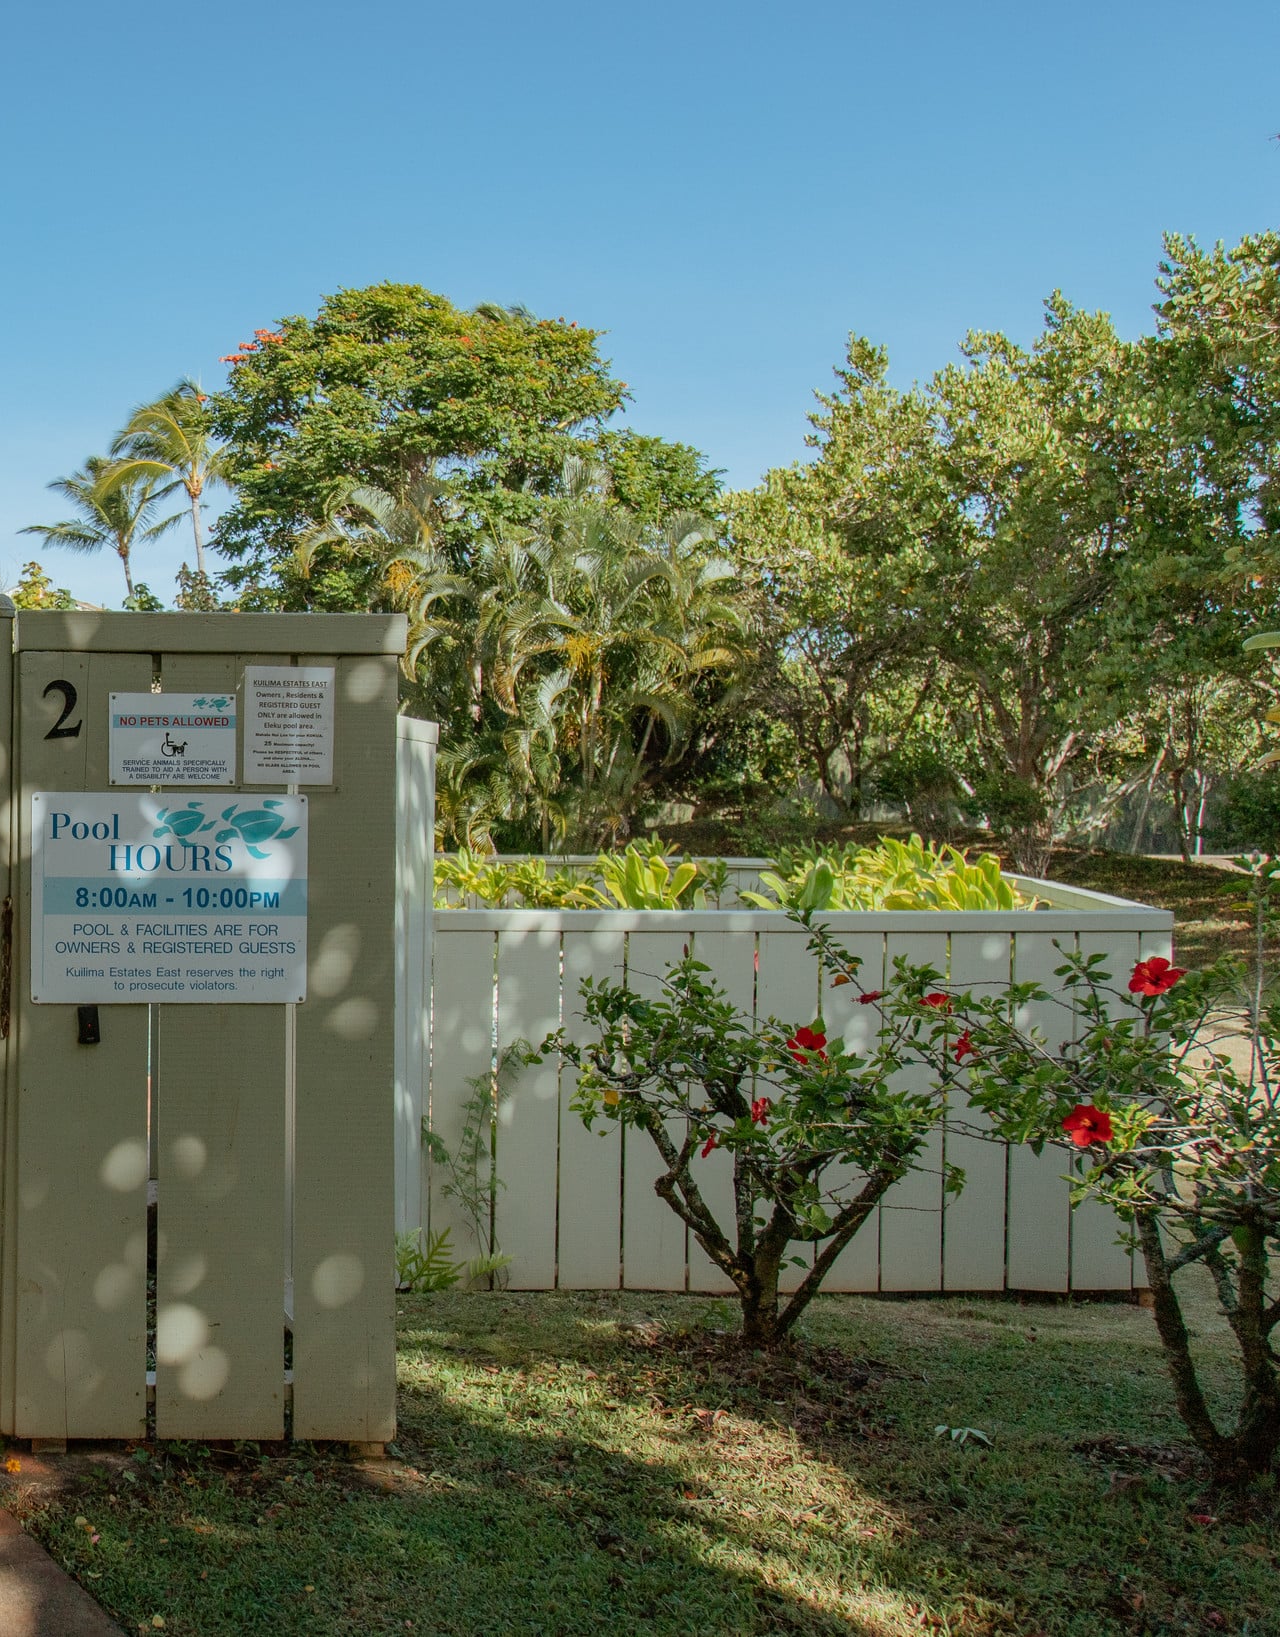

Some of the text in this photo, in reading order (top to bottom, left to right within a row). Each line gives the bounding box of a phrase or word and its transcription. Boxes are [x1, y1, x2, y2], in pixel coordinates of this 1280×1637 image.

[43, 680, 82, 739] 2
[120, 717, 229, 726] NO PETS ALLOWED
[49, 813, 120, 840] Pool
[107, 844, 233, 872] HOURS
[76, 888, 157, 908] 8:00AM
[182, 888, 280, 908] 10:00PM
[73, 924, 279, 936] POOL & FACILITIES ARE FOR
[55, 942, 296, 954] OWNERS & REGISTERED GUESTS
[66, 968, 104, 977] Kuilima
[110, 968, 151, 977] Estates
[157, 968, 181, 977] East
[239, 968, 256, 977] the
[261, 968, 284, 980] right
[114, 981, 238, 992] to prosecute violators.
